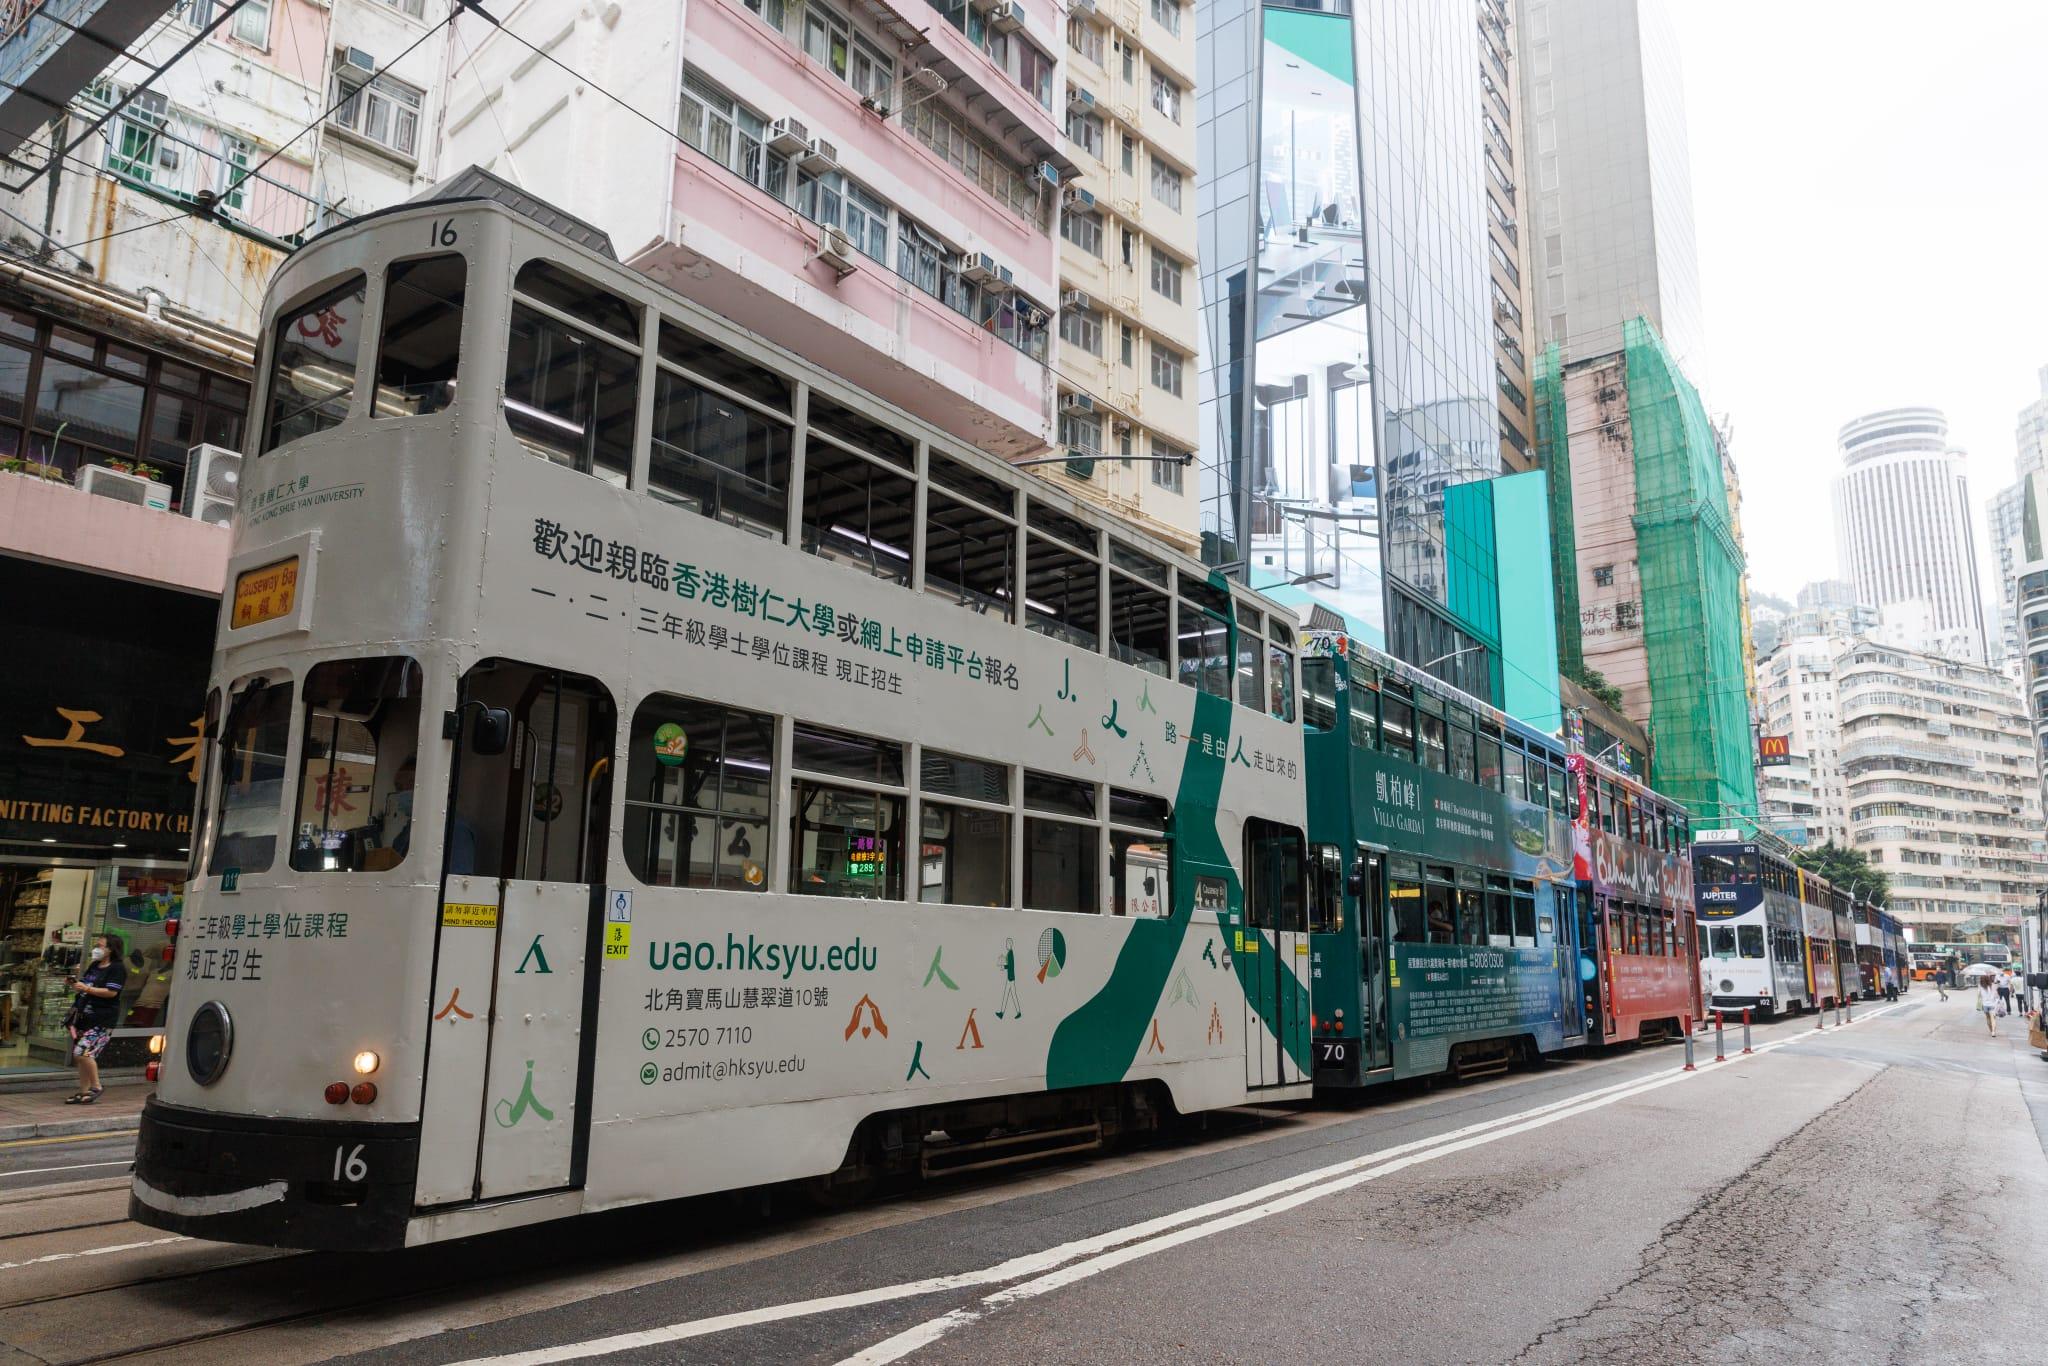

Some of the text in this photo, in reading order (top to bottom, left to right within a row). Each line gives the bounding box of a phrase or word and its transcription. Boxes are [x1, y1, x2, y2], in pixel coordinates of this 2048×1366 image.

[430, 218, 458, 247] 16
[279, 501, 297, 515] SHUE
[297, 498, 312, 510] YAN
[314, 487, 366, 505] UNIVERSITY
[533, 518, 1020, 690] 歡迎親臨香港樹仁大學或網上申請平台報名
[1312, 637, 1331, 650] 70
[835, 657, 903, 696] 現正招生
[78, 806, 167, 832] FACTORY
[1706, 830, 1728, 840] 102
[1702, 891, 1737, 900] JUPITER
[461, 918, 474, 926] THE
[606, 944, 629, 955] EXIT
[649, 933, 877, 980] uao.hksyu.edu
[186, 948, 264, 982] 現正招生
[643, 987, 829, 1012] 北角寶馬山慧翠道10號
[665, 1026, 752, 1049] 2570 7110
[1323, 1043, 1345, 1061] 70
[663, 1055, 806, 1083] admit@hksyu.edu
[332, 1143, 368, 1183] 16
